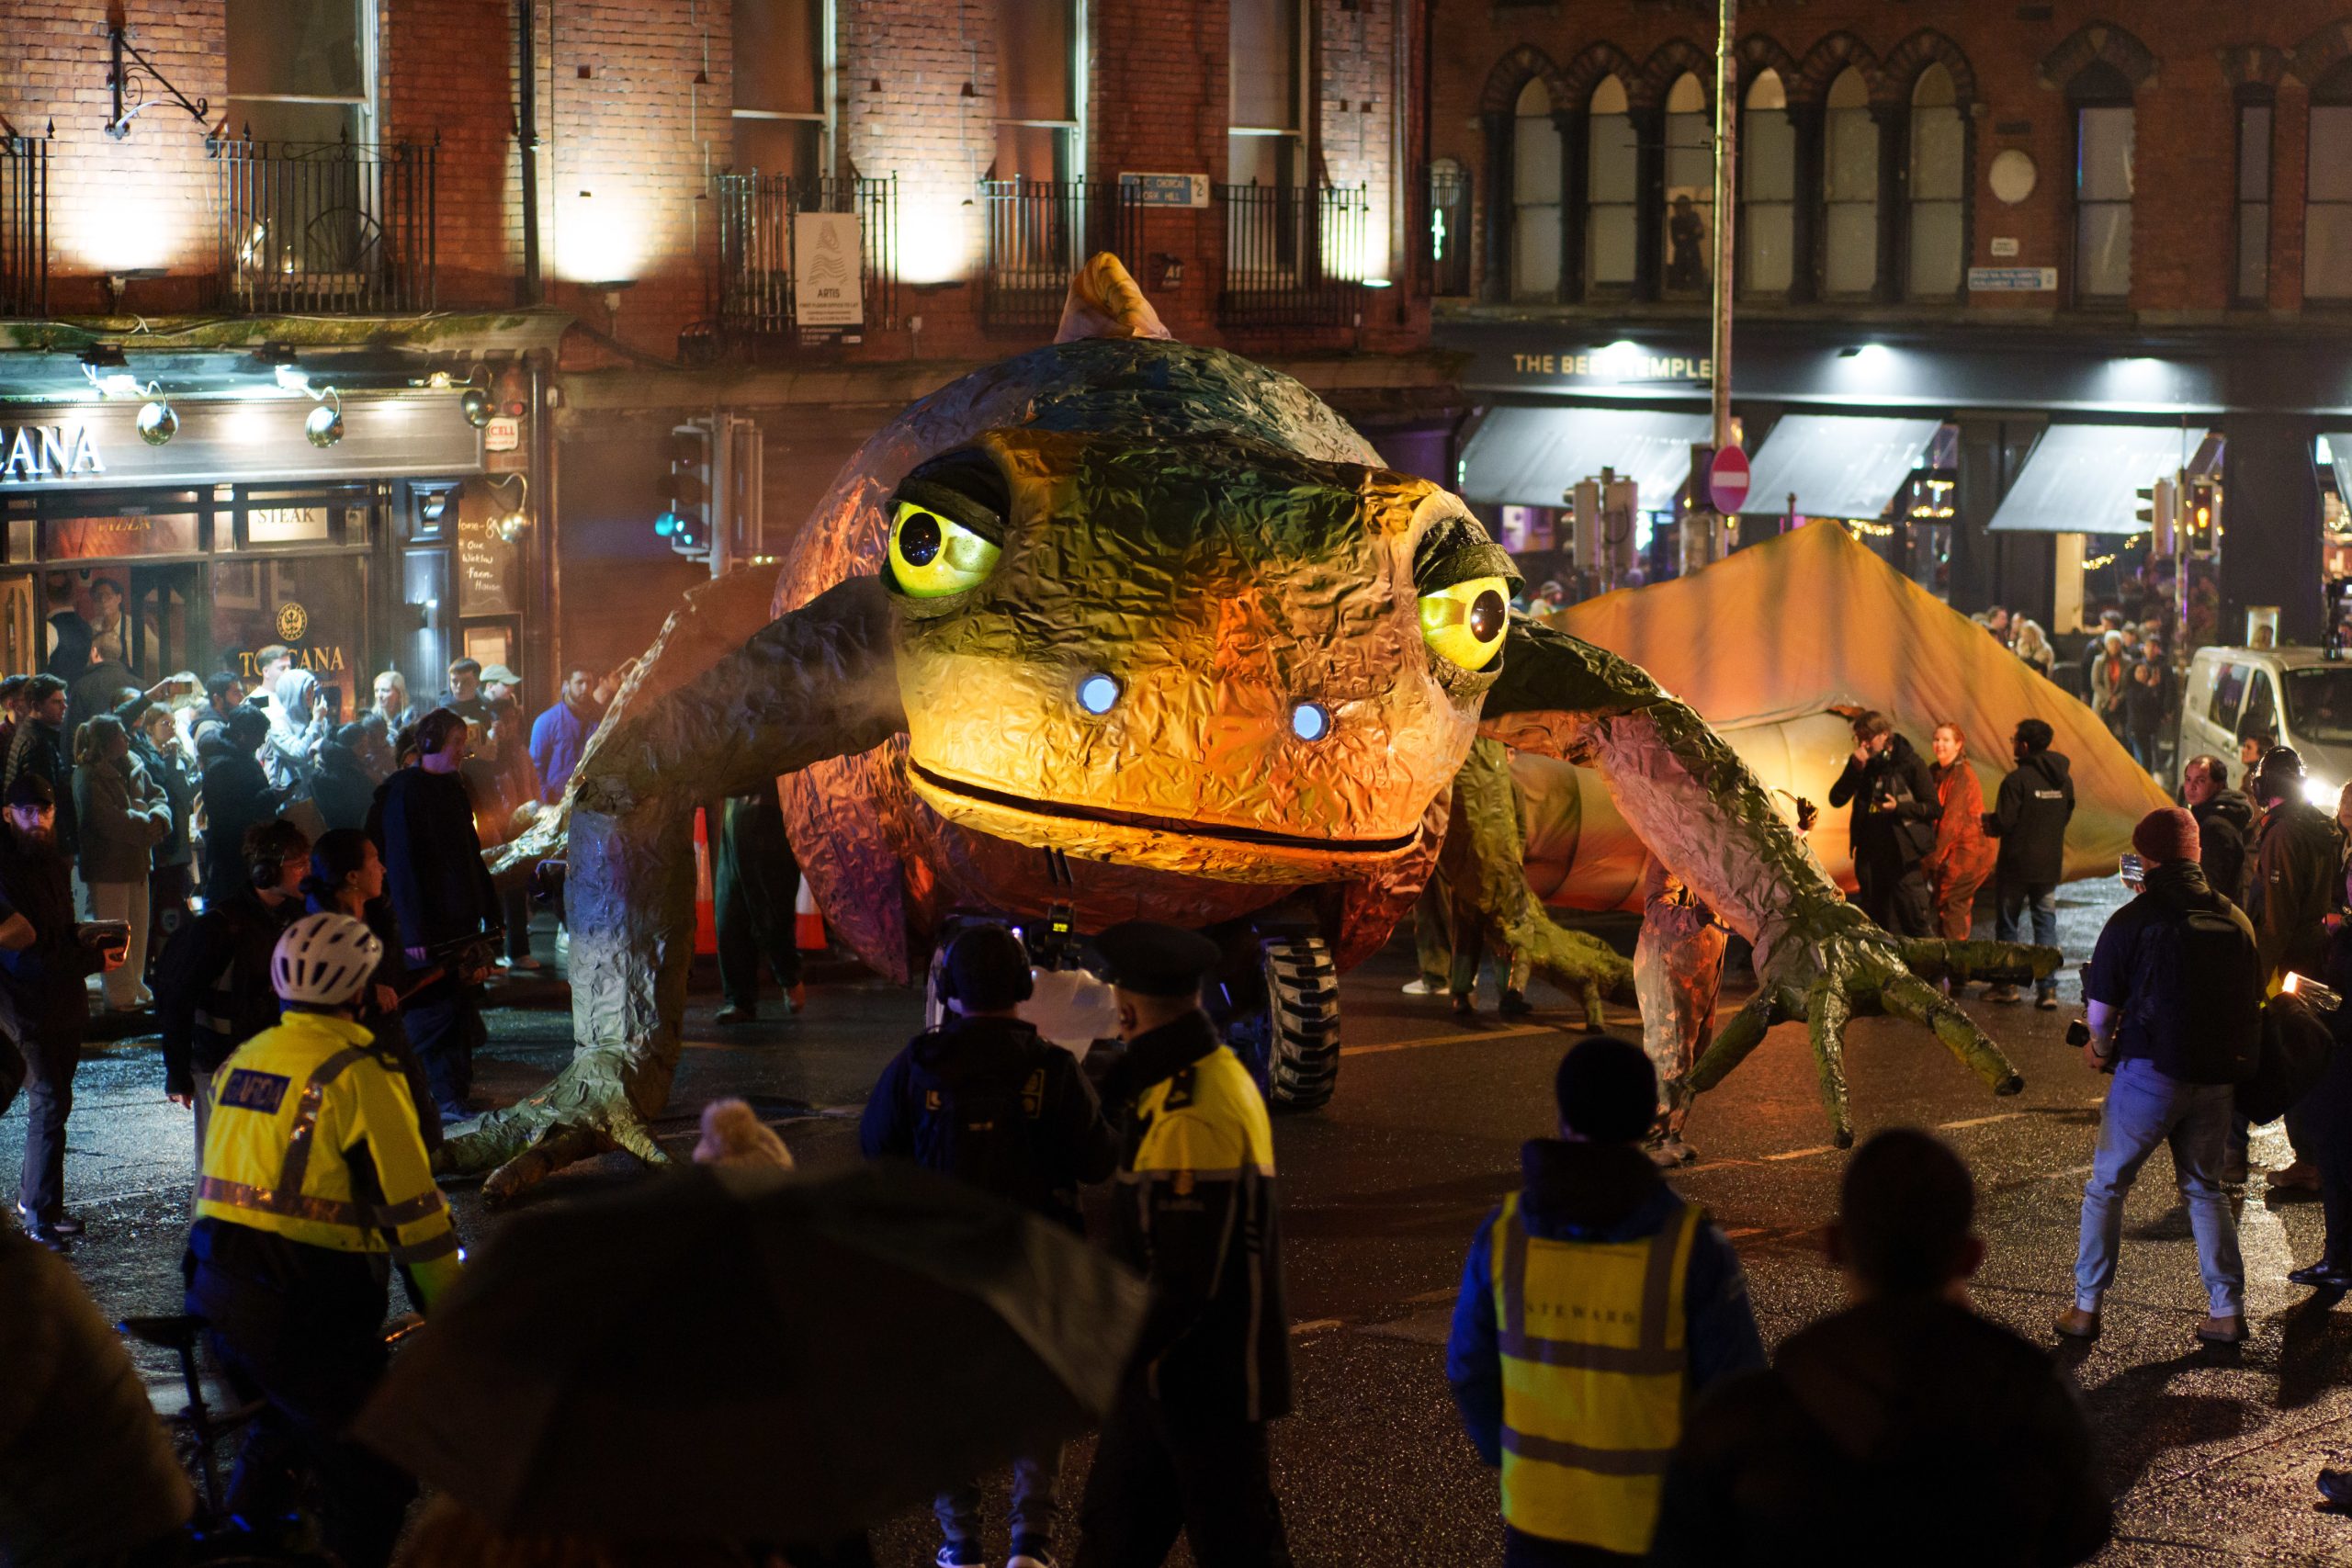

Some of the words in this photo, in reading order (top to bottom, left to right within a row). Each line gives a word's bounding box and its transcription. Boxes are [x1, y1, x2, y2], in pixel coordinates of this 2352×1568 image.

[817, 288, 841, 299] ARTIS
[1513, 354, 1555, 374] THE
[1562, 355, 1618, 376] BEE
[257, 507, 316, 524] STEAK
[239, 646, 345, 678] TOCANA
